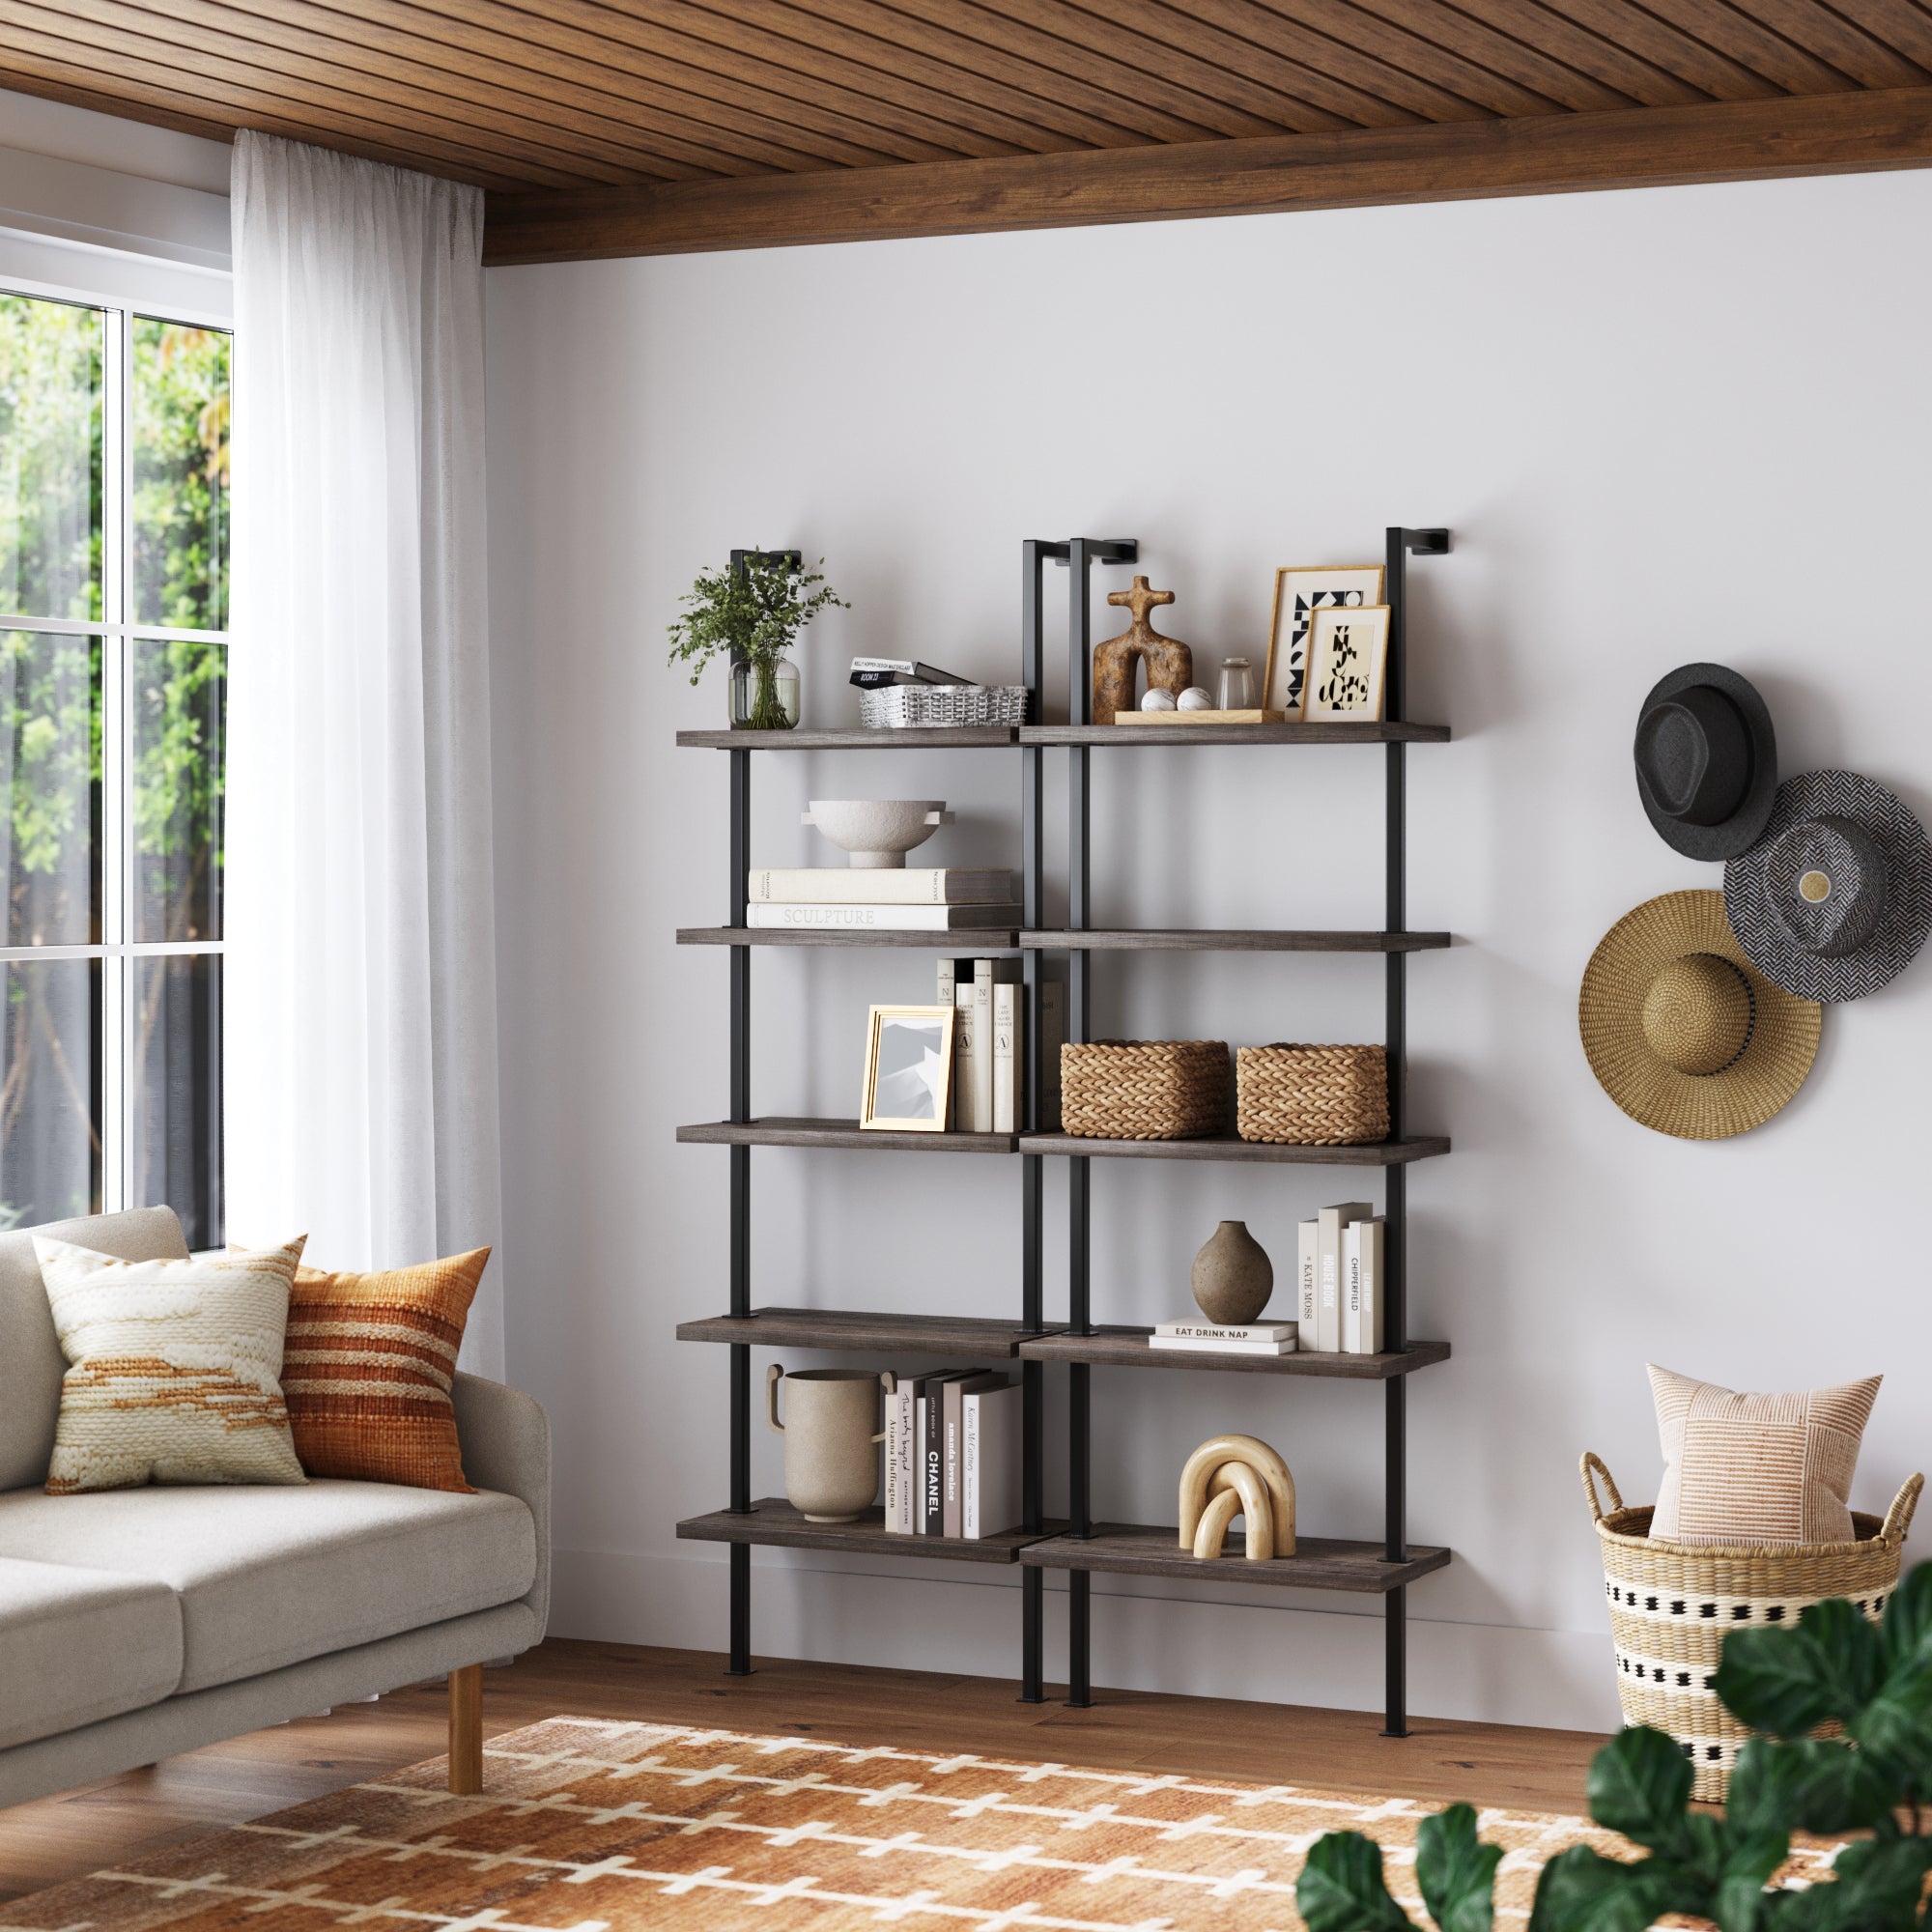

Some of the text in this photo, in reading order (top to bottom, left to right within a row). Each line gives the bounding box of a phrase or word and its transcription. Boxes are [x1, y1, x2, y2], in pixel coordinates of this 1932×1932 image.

[783, 909, 874, 924] SCULPTURE
[1304, 1264, 1313, 1291] KATE
[1322, 1254, 1335, 1309] HOUSE BOOK
[1350, 1257, 1359, 1311] CHIPPERFIELD
[1304, 1293, 1313, 1320] MOSS
[1196, 1329, 1225, 1338] DRINK
[897, 1393, 912, 1471] The body beyond
[967, 1406, 976, 1430] Karen
[948, 1422, 956, 1501] amanda lovelace
[966, 1431, 976, 1471] McCartney
[888, 1459, 897, 1508] Huffington
[928, 1451, 939, 1516] CHANEL
